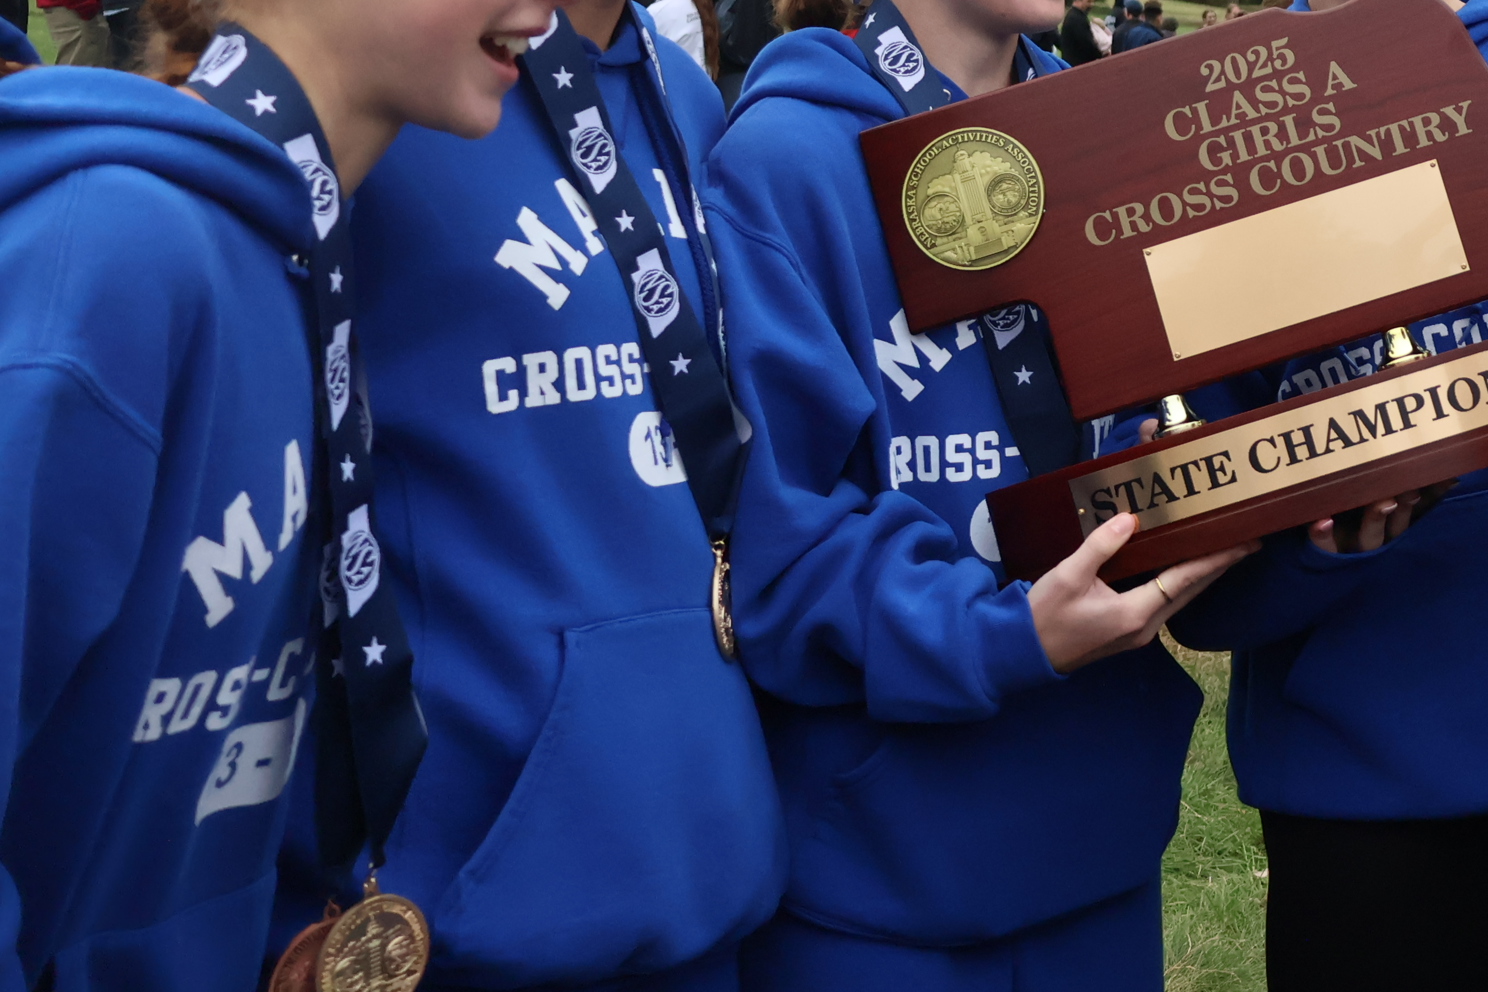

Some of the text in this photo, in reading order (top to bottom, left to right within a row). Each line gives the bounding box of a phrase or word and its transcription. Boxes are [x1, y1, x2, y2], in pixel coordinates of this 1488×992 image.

[1200, 37, 1296, 92] 2025
[1164, 61, 1357, 141] CLASS A
[909, 145, 942, 188] SCHOOL
[942, 132, 1006, 149] ACTIVITIES
[1199, 102, 1341, 171] GIRLS
[1004, 144, 1039, 215] ASSOCIATION
[1084, 174, 1239, 246] CROSS
[1249, 100, 1473, 196] COUNTRY
[907, 191, 935, 249] NEBRASKA
[1090, 449, 1238, 525] STATE
